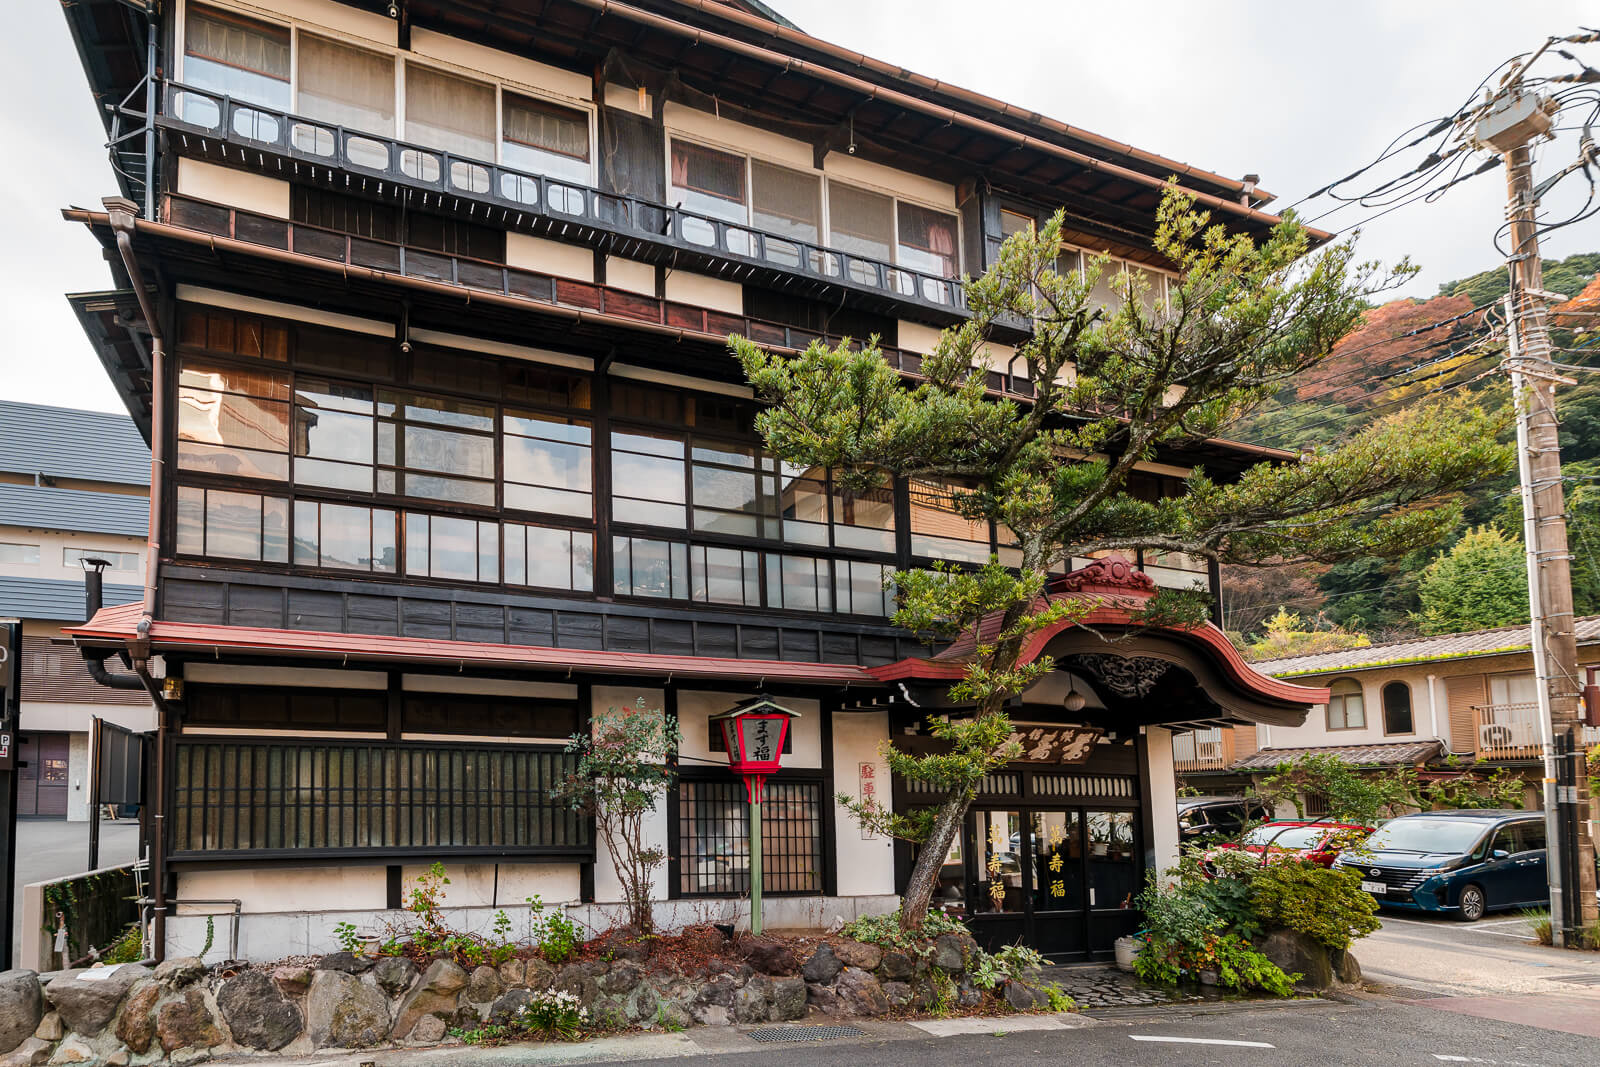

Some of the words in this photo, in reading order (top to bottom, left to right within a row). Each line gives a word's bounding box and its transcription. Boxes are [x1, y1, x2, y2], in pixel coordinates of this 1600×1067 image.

[752, 720, 770, 761] ます福
[1048, 824, 1066, 897] 萬寿福
